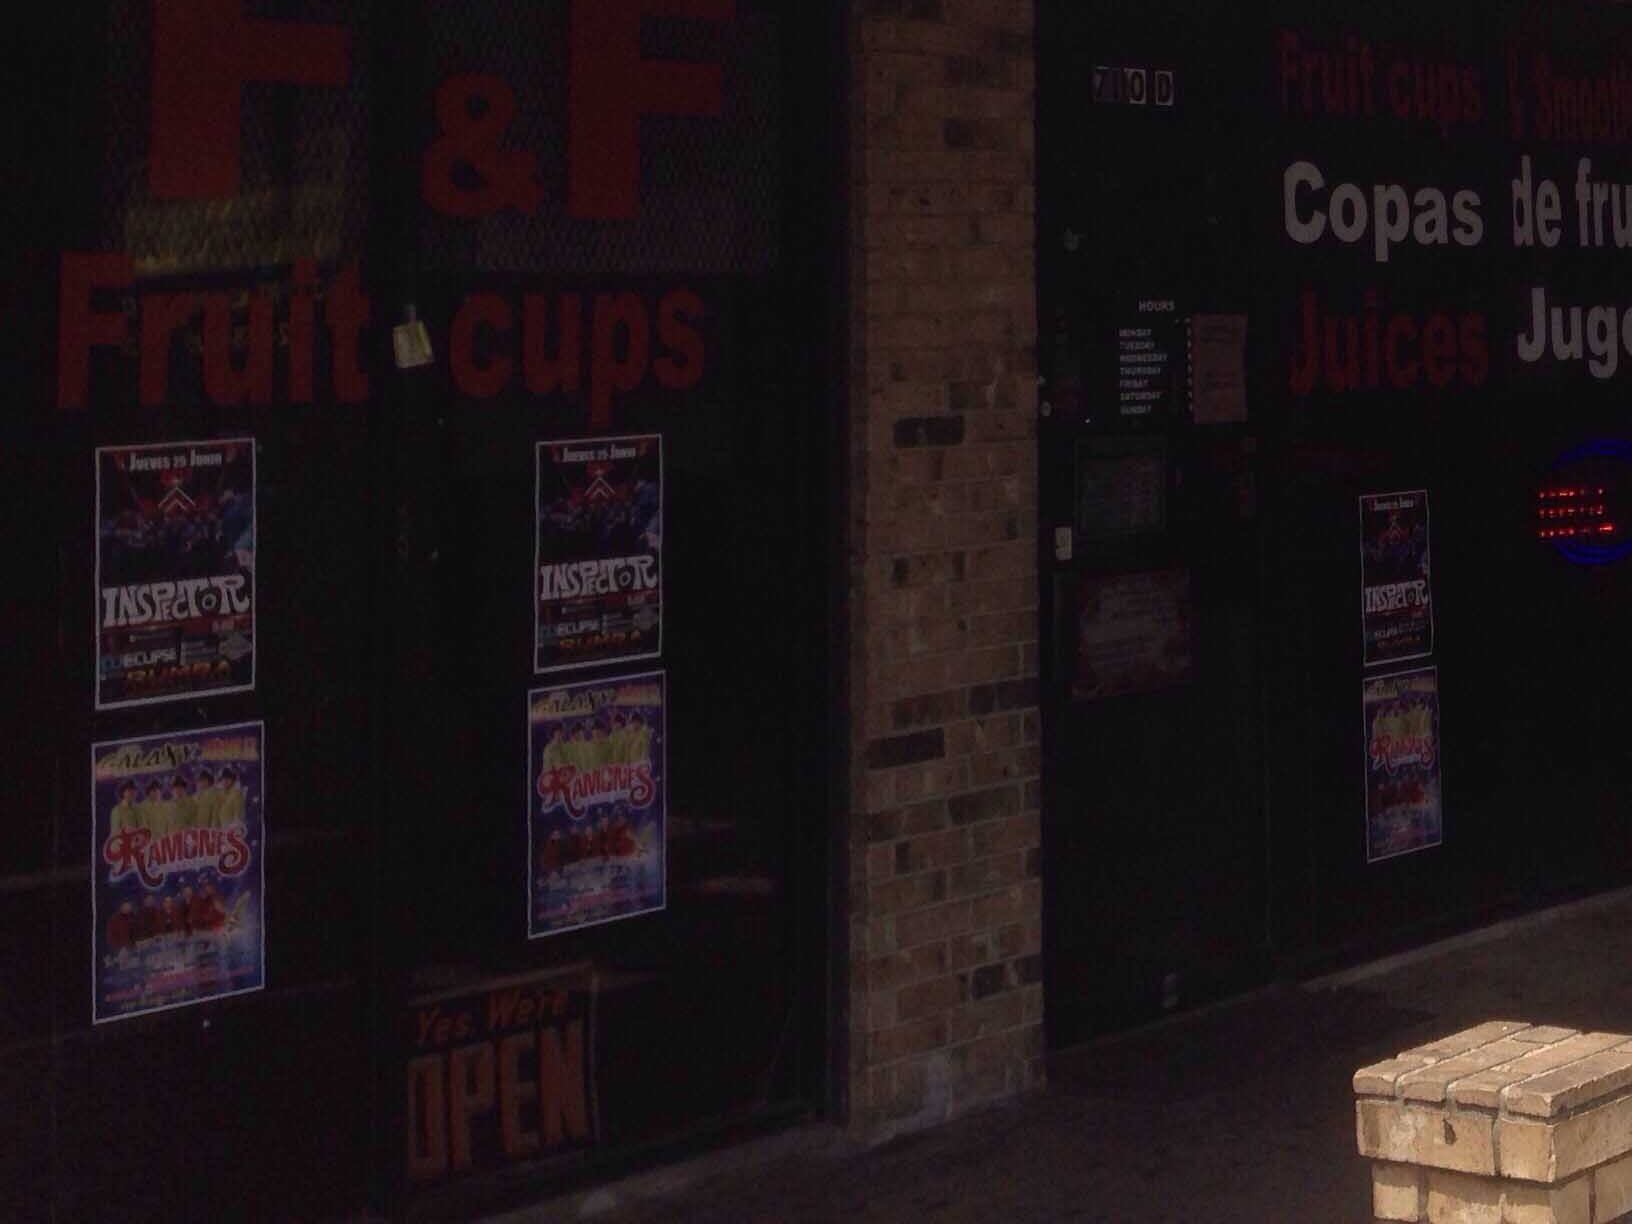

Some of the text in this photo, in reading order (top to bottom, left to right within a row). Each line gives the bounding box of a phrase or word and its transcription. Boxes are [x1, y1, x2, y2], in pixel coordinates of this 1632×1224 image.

[420, 70, 543, 217] &
[1277, 28, 1375, 121] Fruit
[1391, 59, 1484, 150] cups
[1282, 160, 1485, 263] Copas
[1511, 154, 1562, 249] de
[54, 250, 706, 429] Fruit cups
[1138, 299, 1176, 313] HOURS
[1287, 280, 1488, 395] Juices
[101, 573, 250, 627] INSPECTOR
[541, 555, 657, 601] INSPECTOR
[104, 826, 250, 886] RAMONES
[406, 1016, 588, 1179] OPEN
